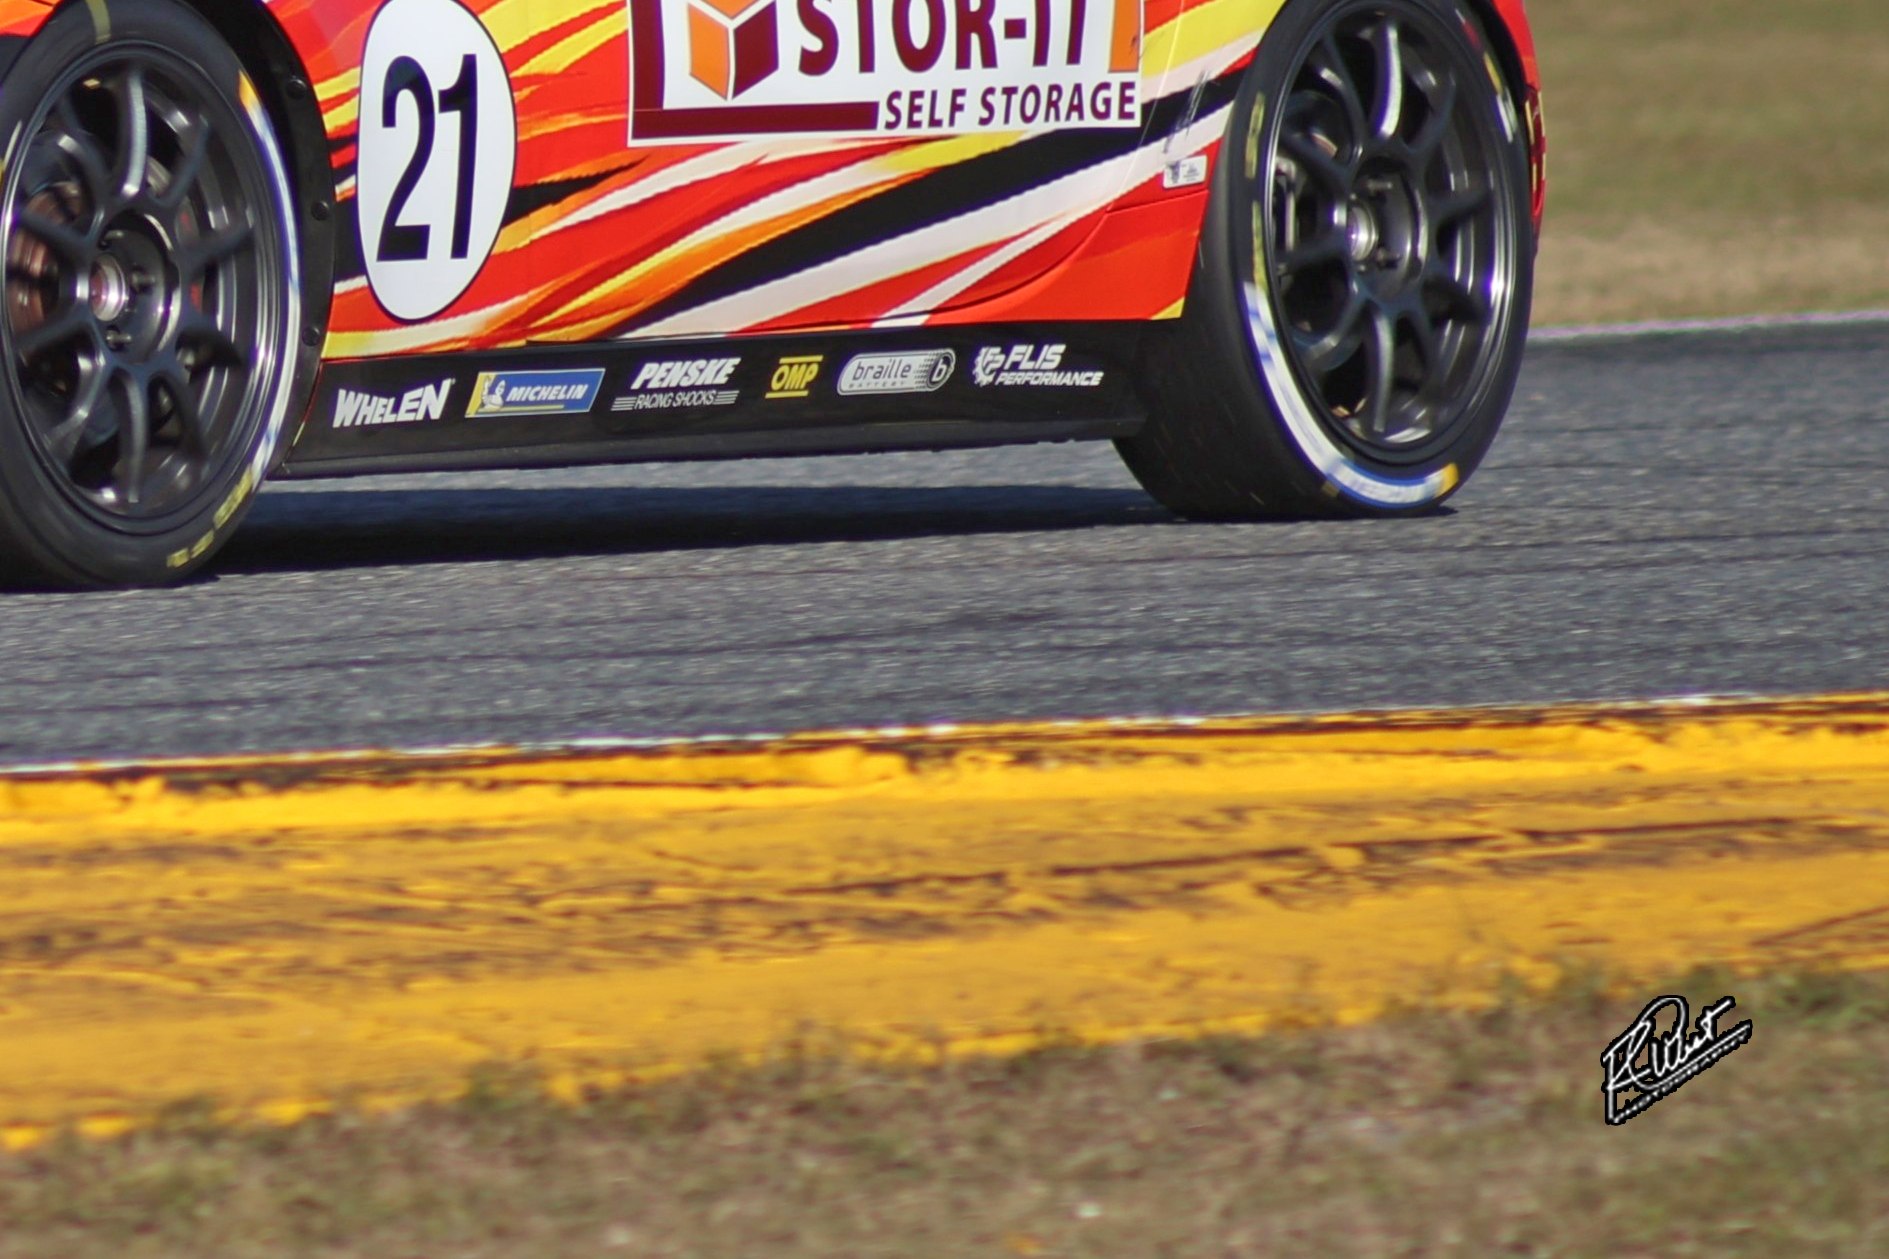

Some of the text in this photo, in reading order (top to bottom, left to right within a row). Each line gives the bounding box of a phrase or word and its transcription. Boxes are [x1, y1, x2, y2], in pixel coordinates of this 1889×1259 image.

[885, 81, 1137, 130] SELF STORAGE
[376, 53, 479, 262] 21
[852, 358, 912, 381] braille
[1003, 344, 1066, 370] FLIS
[630, 357, 742, 390] PENSKE
[771, 362, 820, 391] OMP
[995, 371, 1104, 386] PERFORMANCE
[332, 378, 452, 428] WHELEN
[506, 384, 589, 402] MICHELIN
[634, 391, 716, 410] RACING SHOCKS
